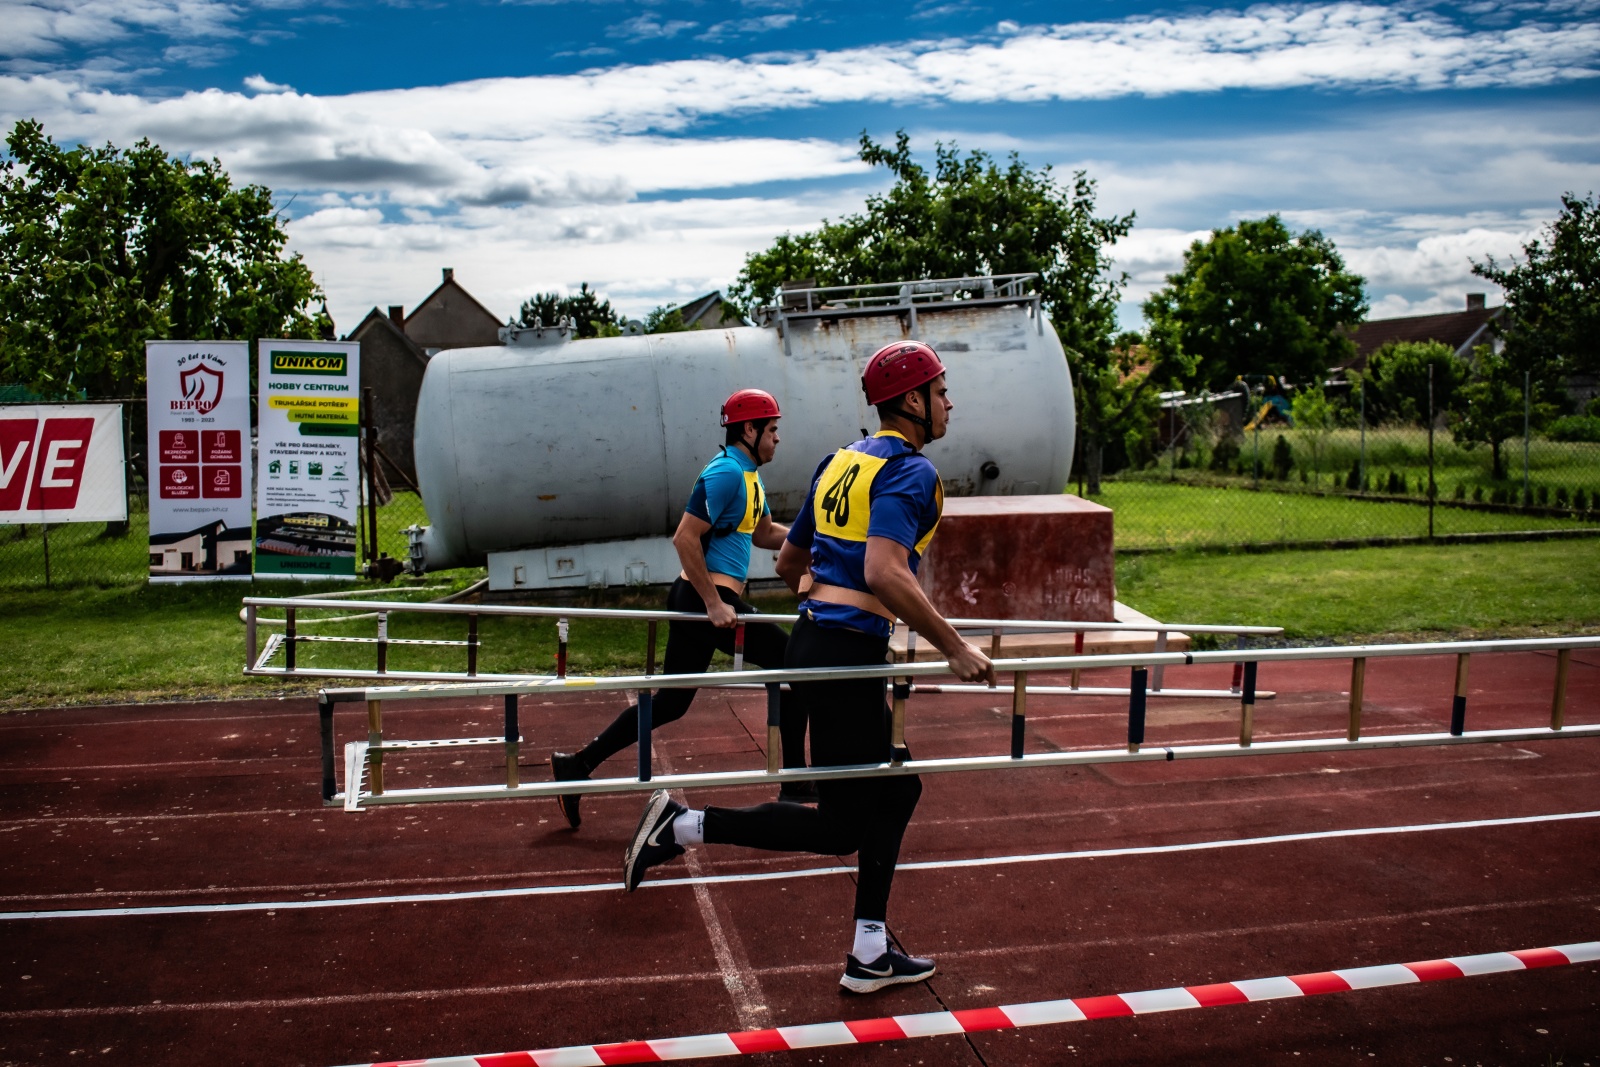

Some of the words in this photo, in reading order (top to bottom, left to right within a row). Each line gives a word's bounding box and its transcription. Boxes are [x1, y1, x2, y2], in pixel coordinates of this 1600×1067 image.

[177, 357, 187, 367] 30
[188, 353, 199, 361] let
[275, 356, 343, 369] UNIKOM
[268, 382, 301, 390] HOBBY
[303, 383, 349, 391] CENTRUM
[274, 399, 317, 407] TRUHLÁŘSKÉ
[318, 400, 349, 408] POTŘEBY
[316, 412, 349, 420] MATERIÁL
[821, 463, 861, 528] 48
[280, 561, 332, 569] UNIKOM.CZ
